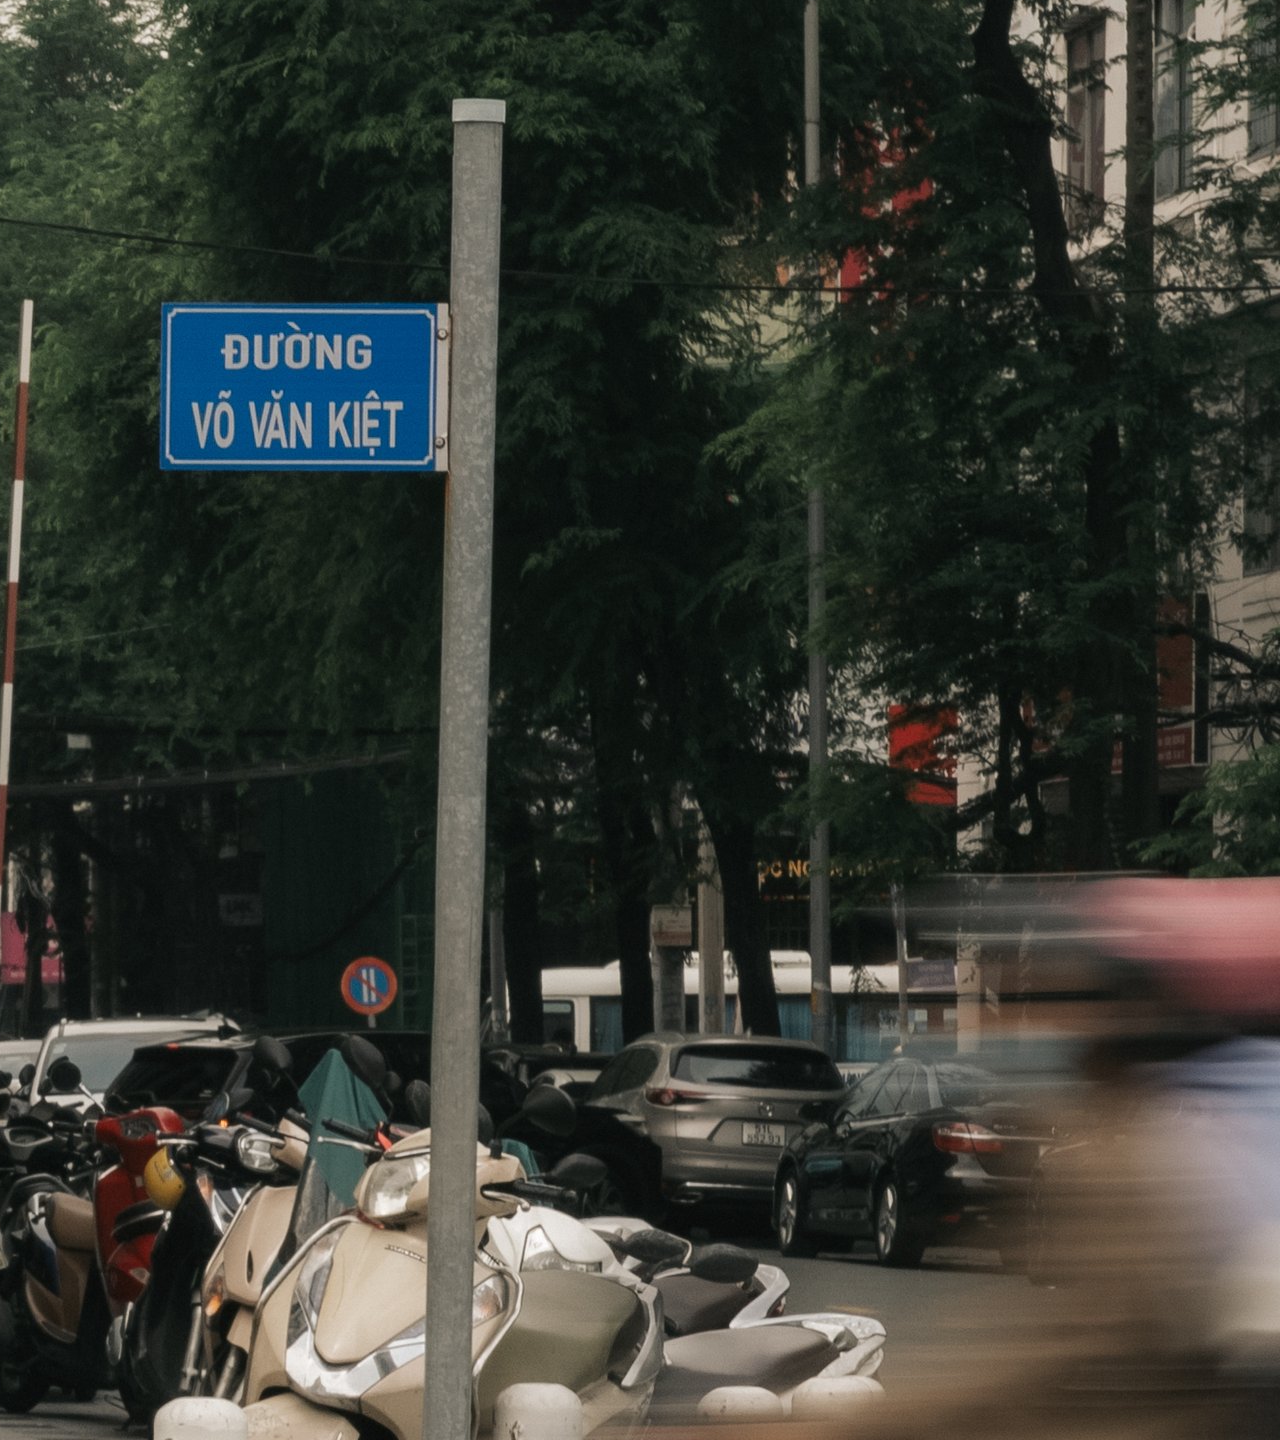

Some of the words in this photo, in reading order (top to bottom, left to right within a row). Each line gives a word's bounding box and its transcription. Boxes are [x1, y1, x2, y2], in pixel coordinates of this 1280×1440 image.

[220, 321, 373, 371] ĐƯỜNG
[190, 389, 236, 449] VÕ
[248, 389, 313, 449] VĂN
[328, 389, 404, 457] KIỆT
